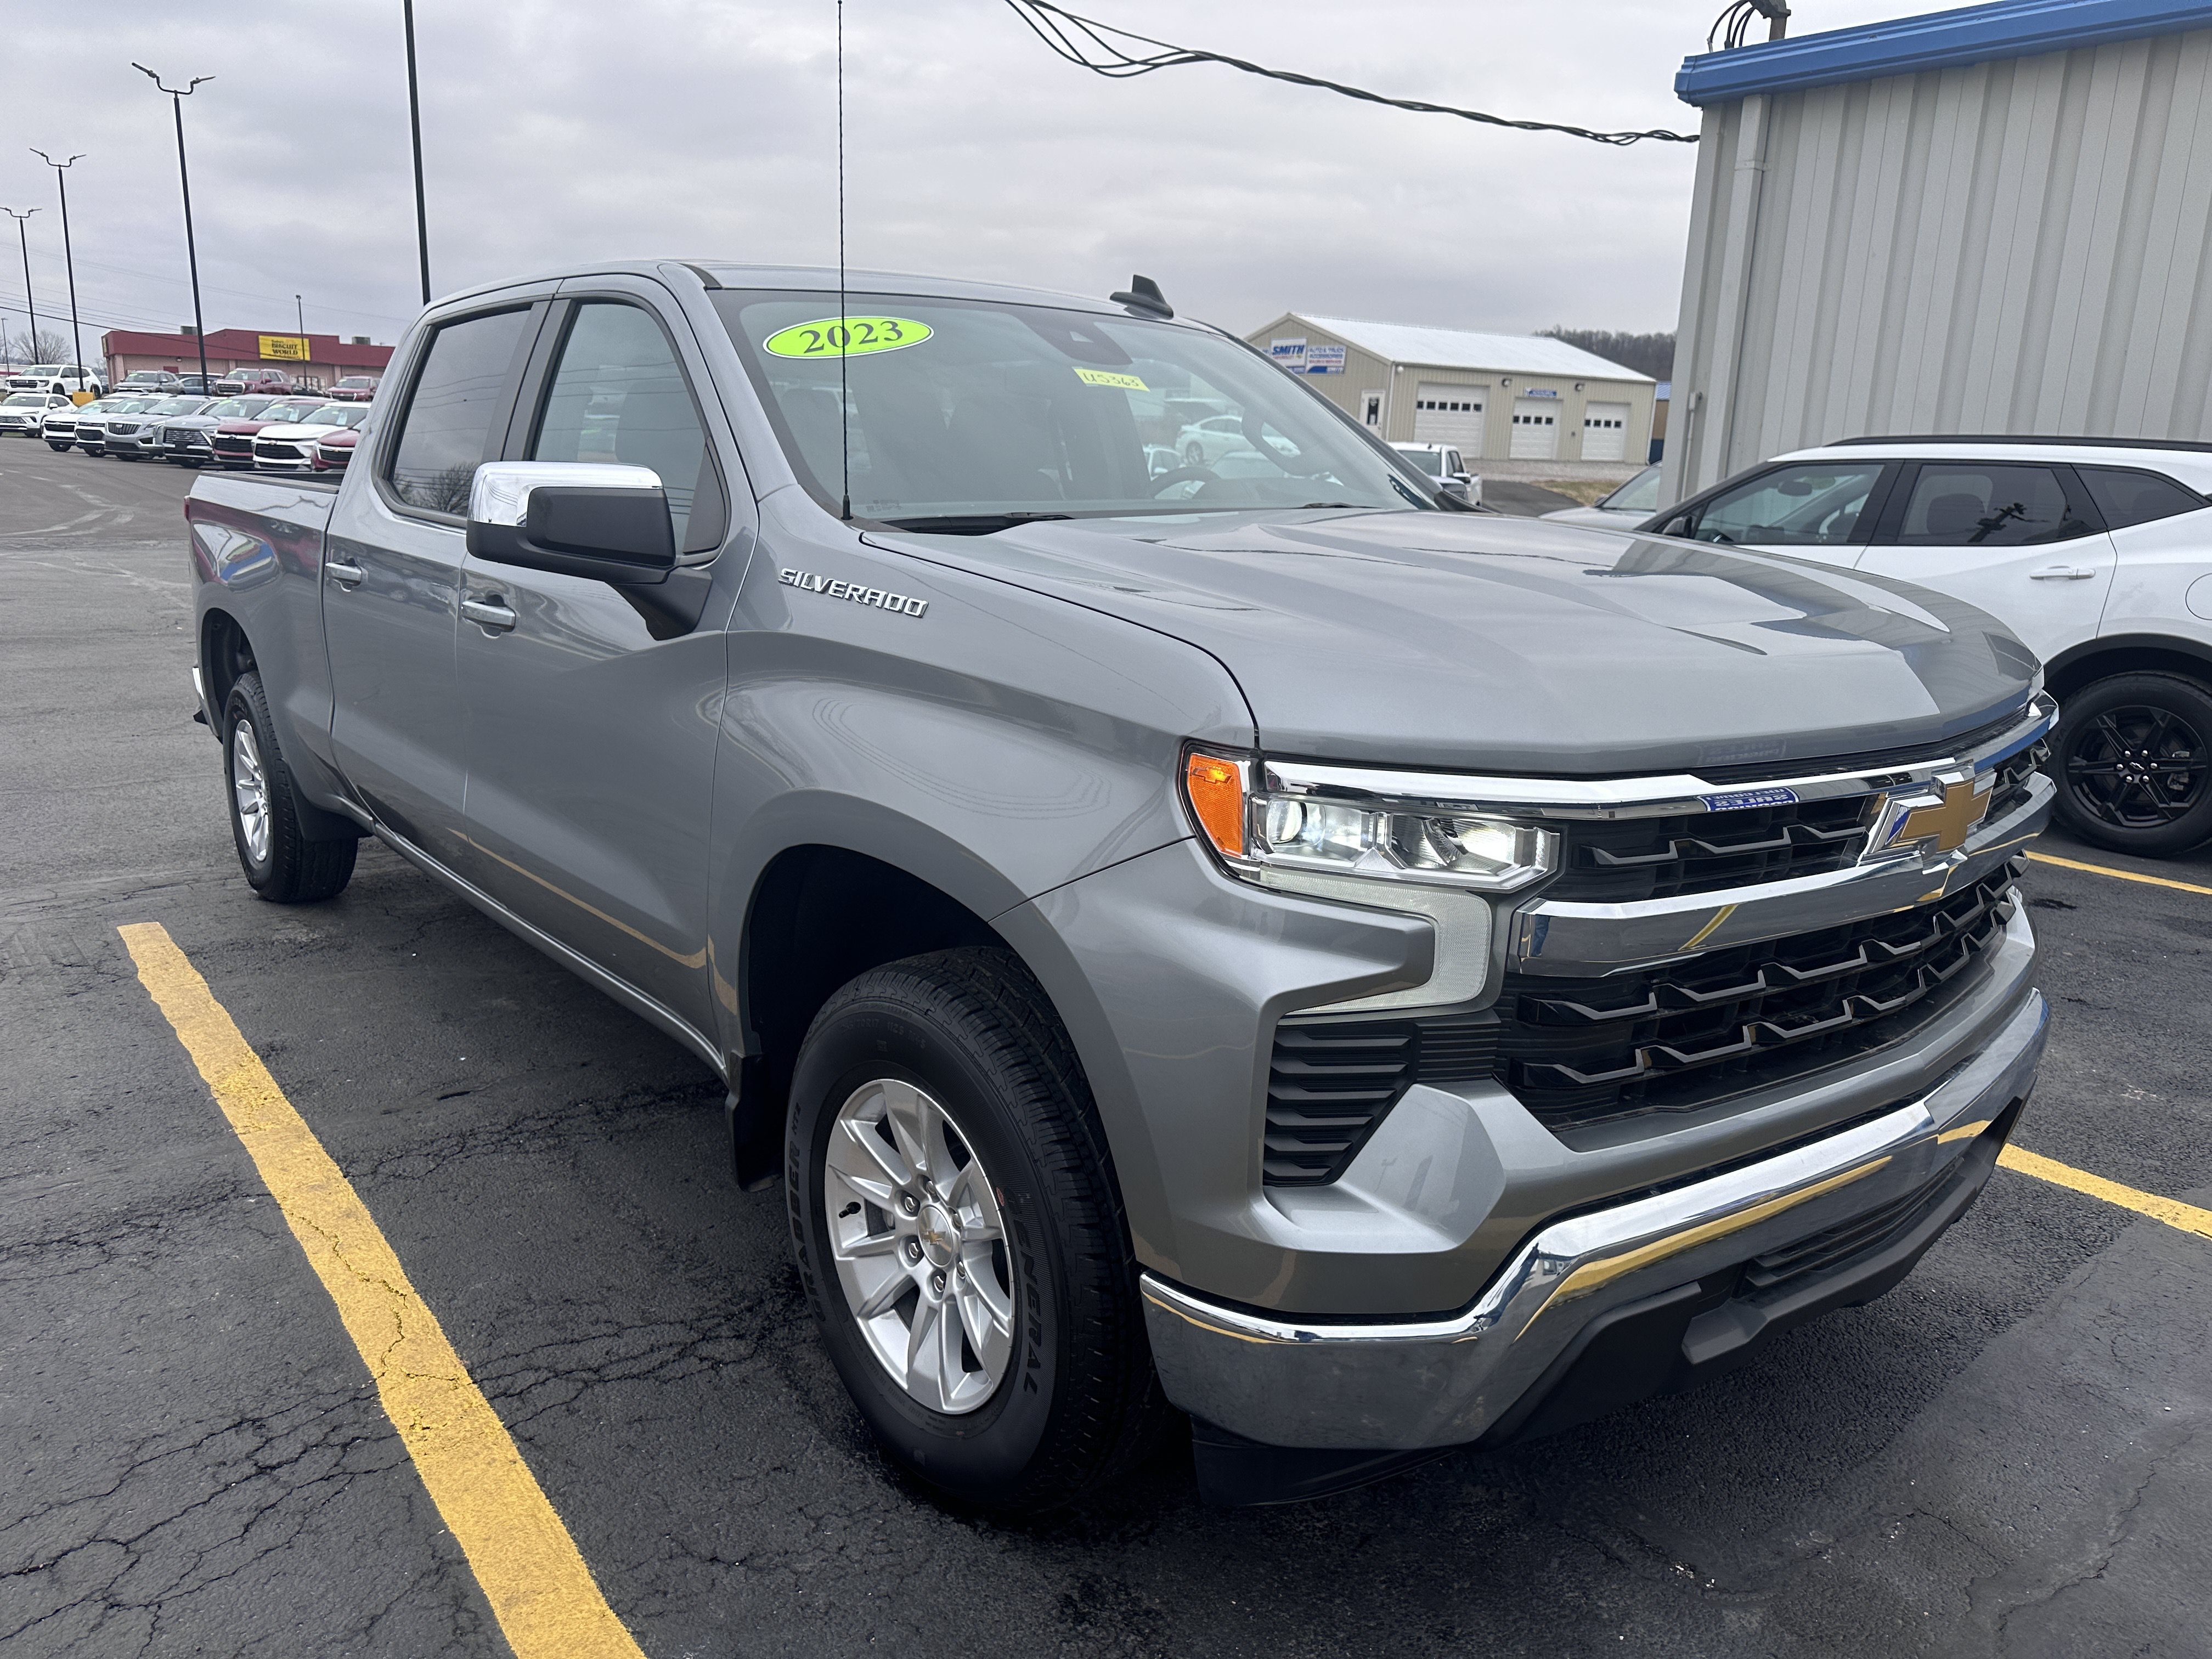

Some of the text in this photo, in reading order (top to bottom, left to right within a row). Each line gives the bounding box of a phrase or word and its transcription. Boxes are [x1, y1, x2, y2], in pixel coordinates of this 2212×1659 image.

[799, 321, 903, 354] 2023
[1272, 345, 1305, 356] SMITH
[778, 568, 929, 618] SILVERADO
[1004, 1188, 1041, 1394] GENERAL
